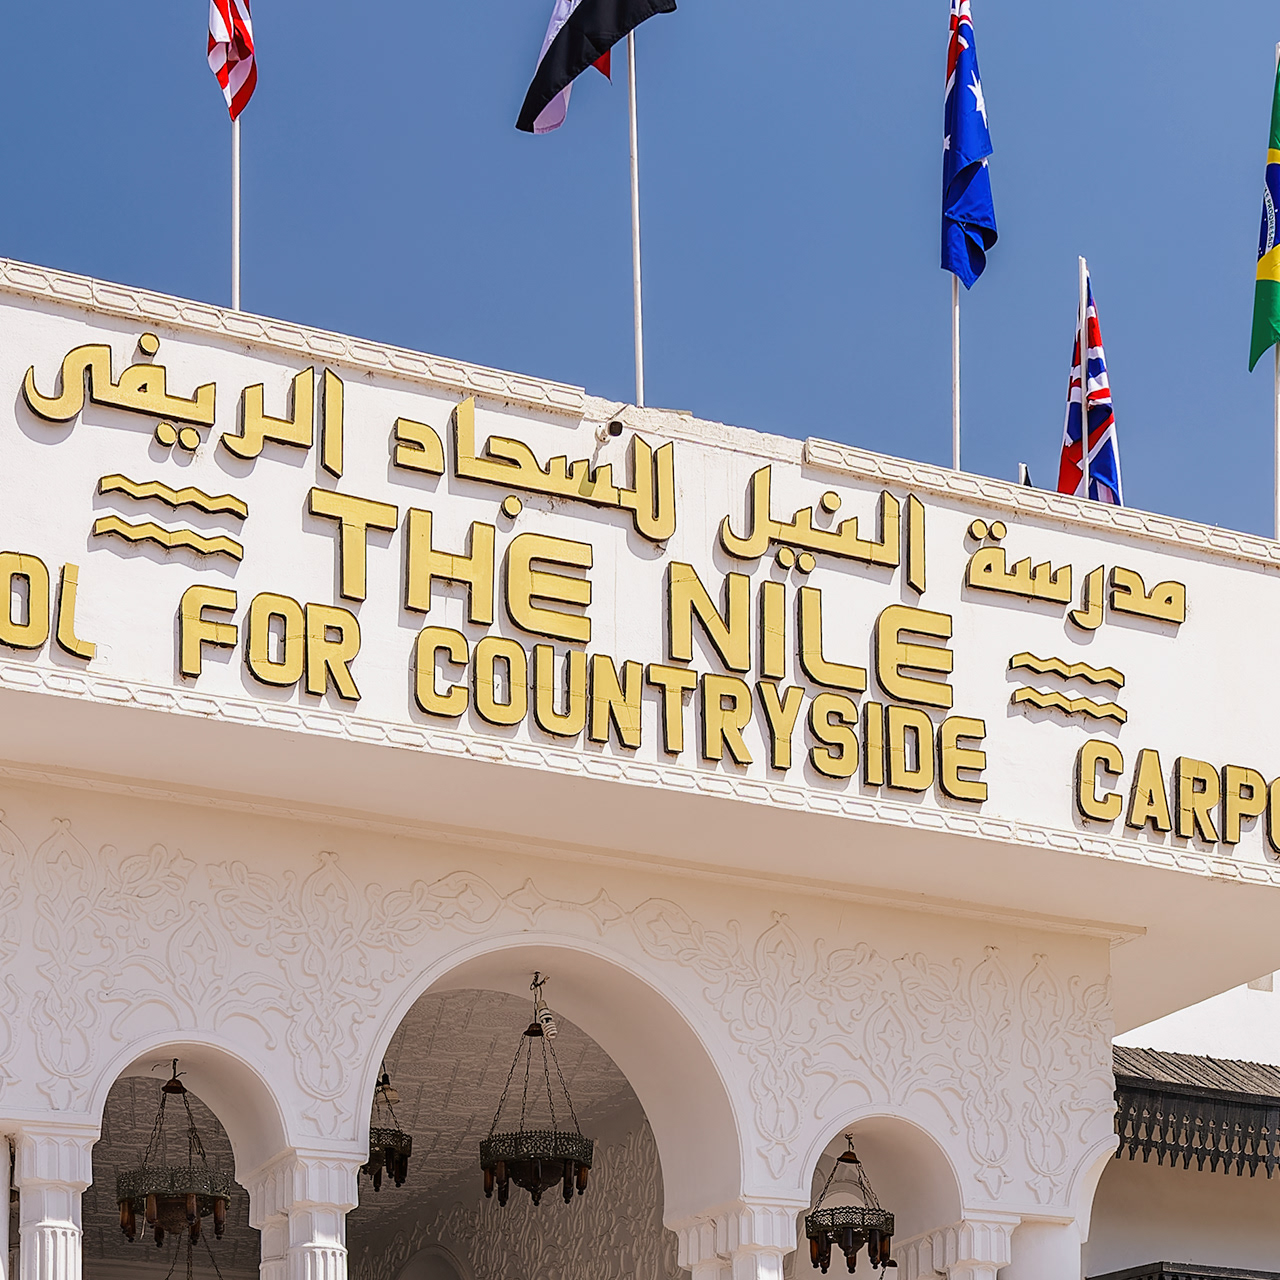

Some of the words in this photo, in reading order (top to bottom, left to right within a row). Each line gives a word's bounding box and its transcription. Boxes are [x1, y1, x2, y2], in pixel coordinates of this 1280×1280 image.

[394, 394, 677, 542] للسجاد
[721, 464, 927, 594] النيل
[307, 486, 594, 642] THE
[668, 560, 954, 709] NILE
[967, 518, 1187, 630] مدرسة
[177, 584, 363, 701] FOR
[412, 625, 989, 803] COUNTRYSIDE
